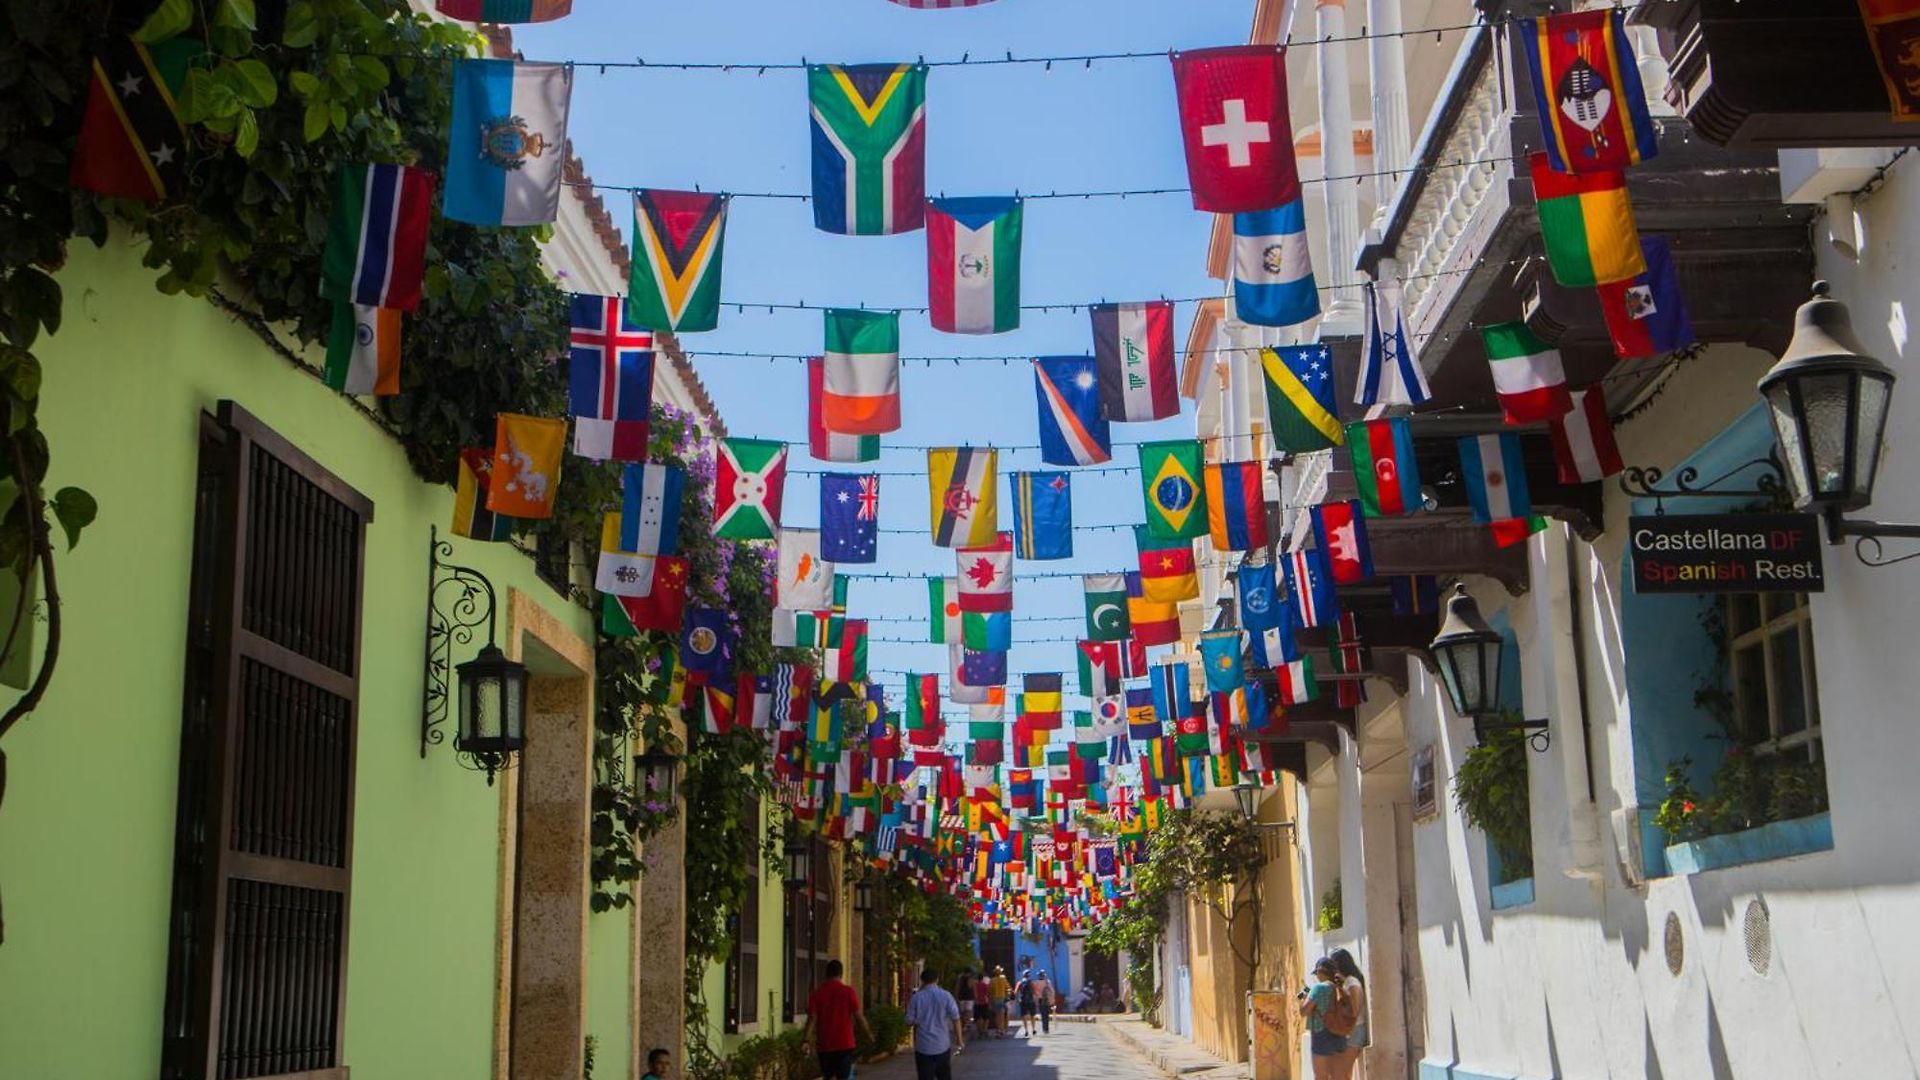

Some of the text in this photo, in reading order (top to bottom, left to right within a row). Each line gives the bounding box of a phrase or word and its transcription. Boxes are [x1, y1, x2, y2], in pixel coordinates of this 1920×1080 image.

[1635, 529, 1802, 551] Castellana DF
[1643, 559, 1821, 584] Spanish Rest.
